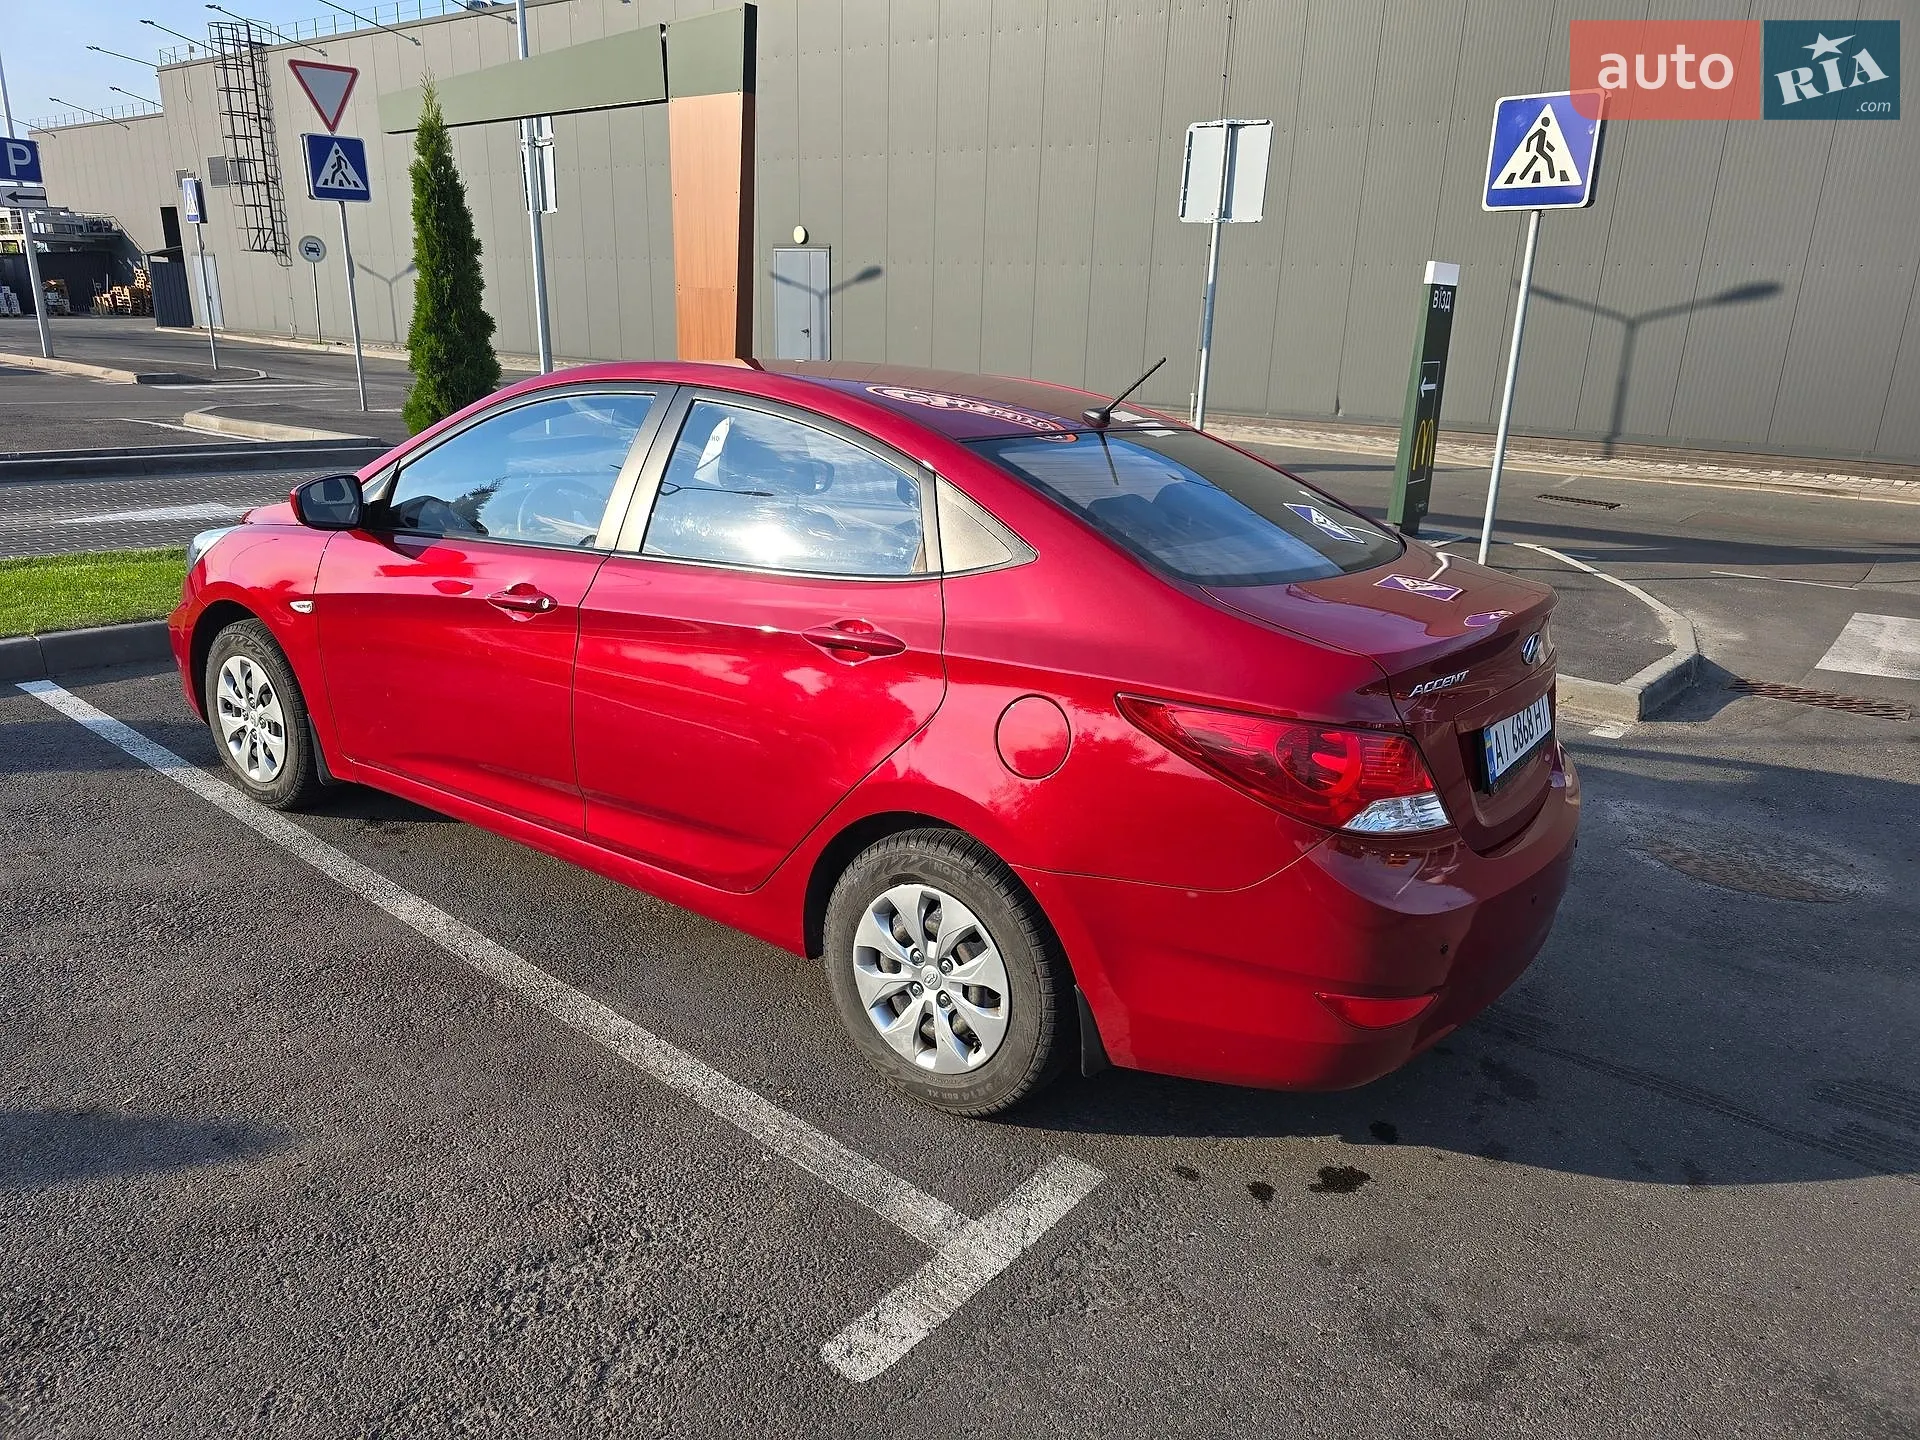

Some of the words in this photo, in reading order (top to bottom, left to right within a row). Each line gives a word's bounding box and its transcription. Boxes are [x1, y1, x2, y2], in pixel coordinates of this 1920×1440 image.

[6, 142, 32, 176] P
[1408, 670, 1470, 697] ACCENT
[1494, 724, 1510, 770] AI
[1511, 706, 1535, 754] 6868
[1533, 696, 1548, 736] HI
